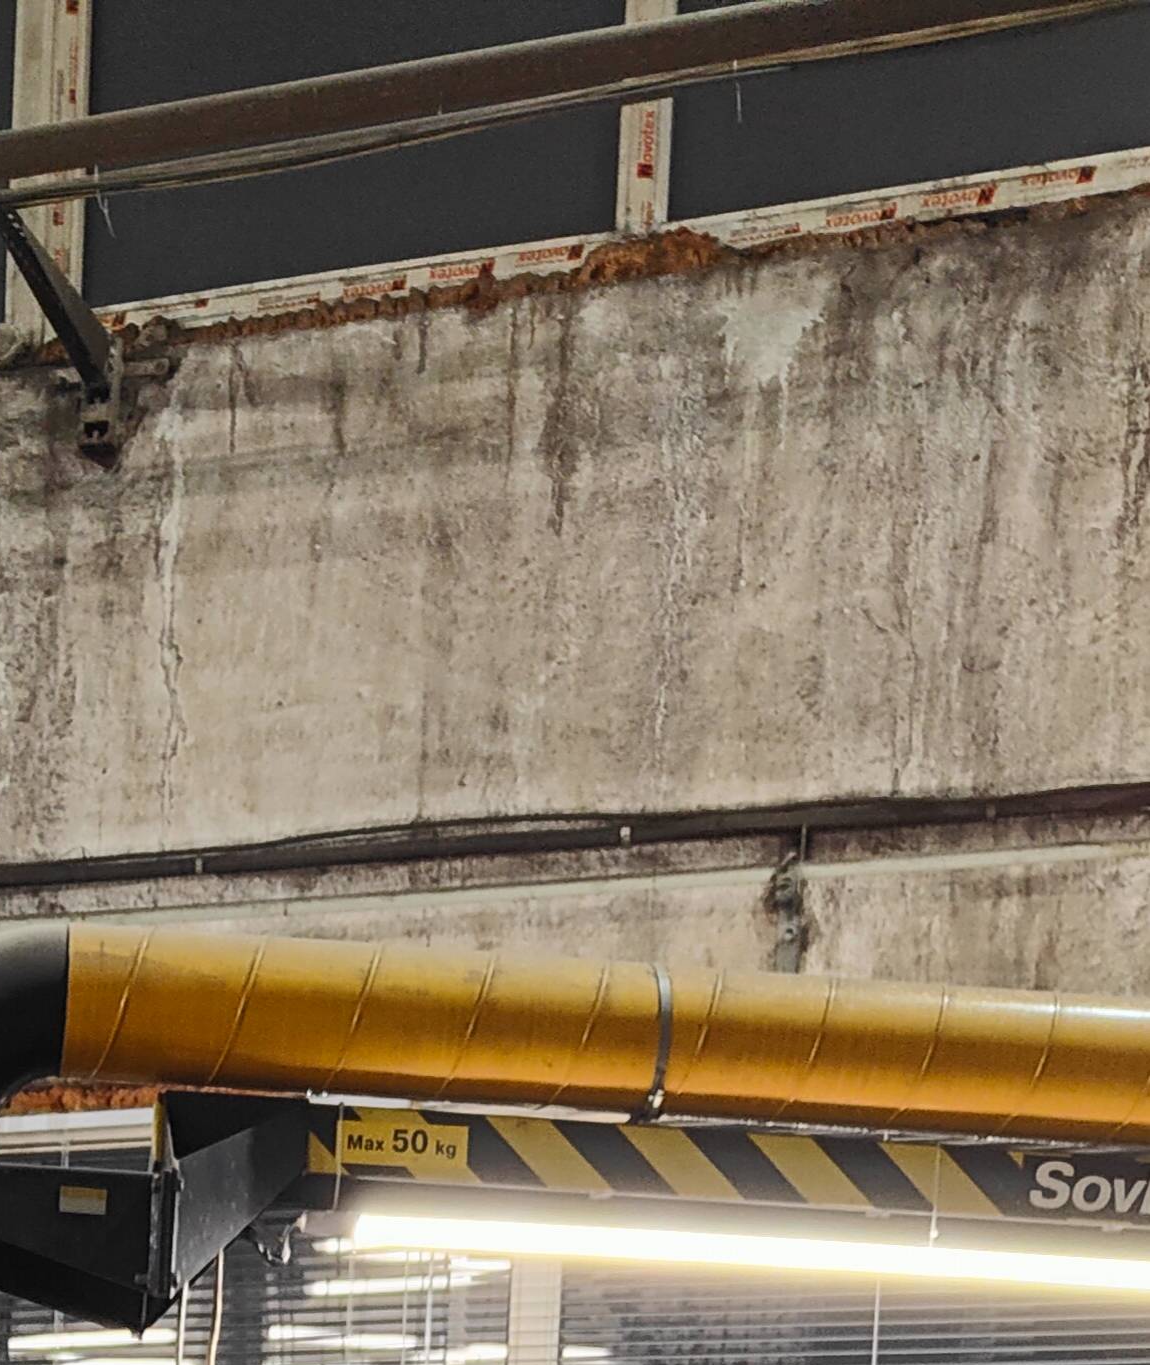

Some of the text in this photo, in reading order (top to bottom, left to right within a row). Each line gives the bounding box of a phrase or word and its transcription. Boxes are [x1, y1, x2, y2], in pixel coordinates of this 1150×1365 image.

[637, 111, 654, 179] Novotex
[922, 181, 997, 206] Novotex
[347, 1128, 457, 1159] Max 50 kg
